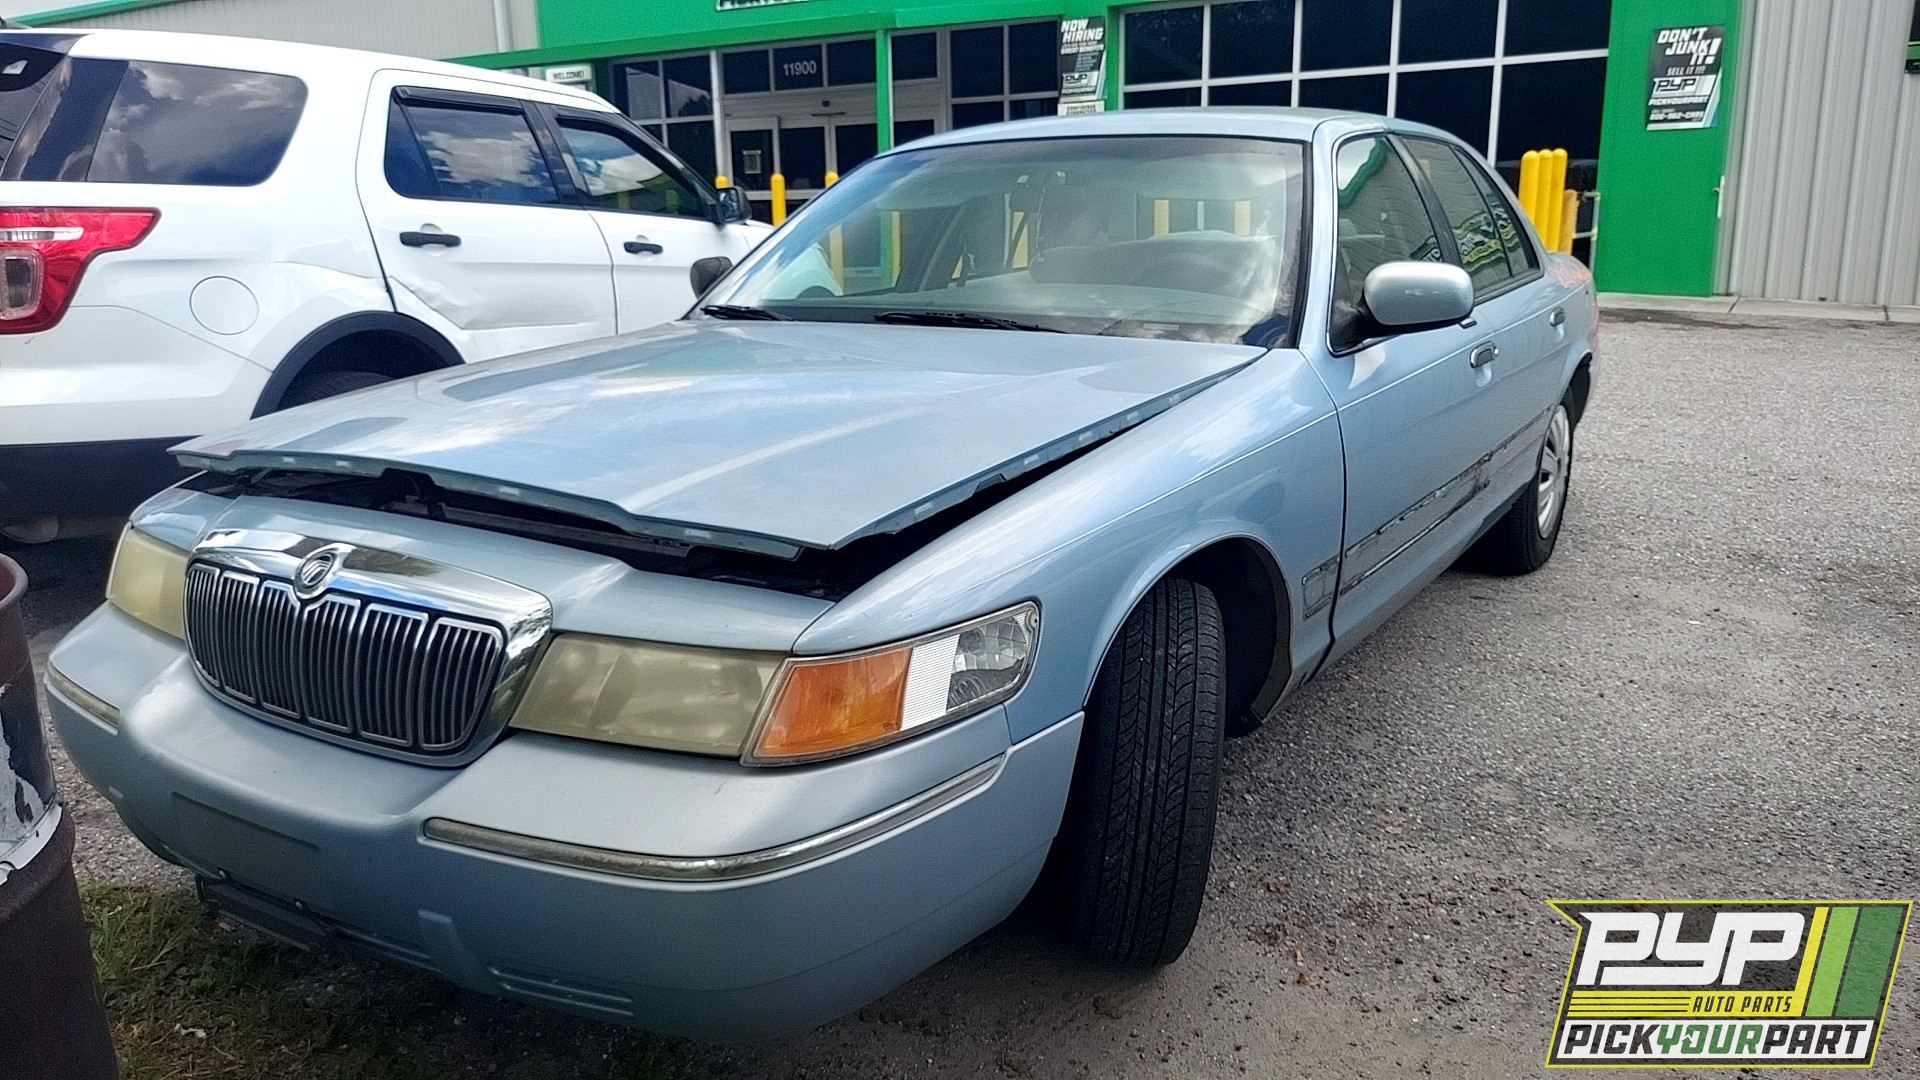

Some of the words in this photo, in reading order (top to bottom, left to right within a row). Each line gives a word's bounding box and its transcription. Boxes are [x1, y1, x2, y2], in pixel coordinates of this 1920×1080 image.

[1061, 19, 1089, 32] NOW
[1063, 28, 1104, 43] HIRING
[1657, 27, 1708, 43] DON'T
[783, 61, 817, 76] 11900
[1666, 66, 1685, 76] SELL
[1656, 78, 1697, 91] PYP
